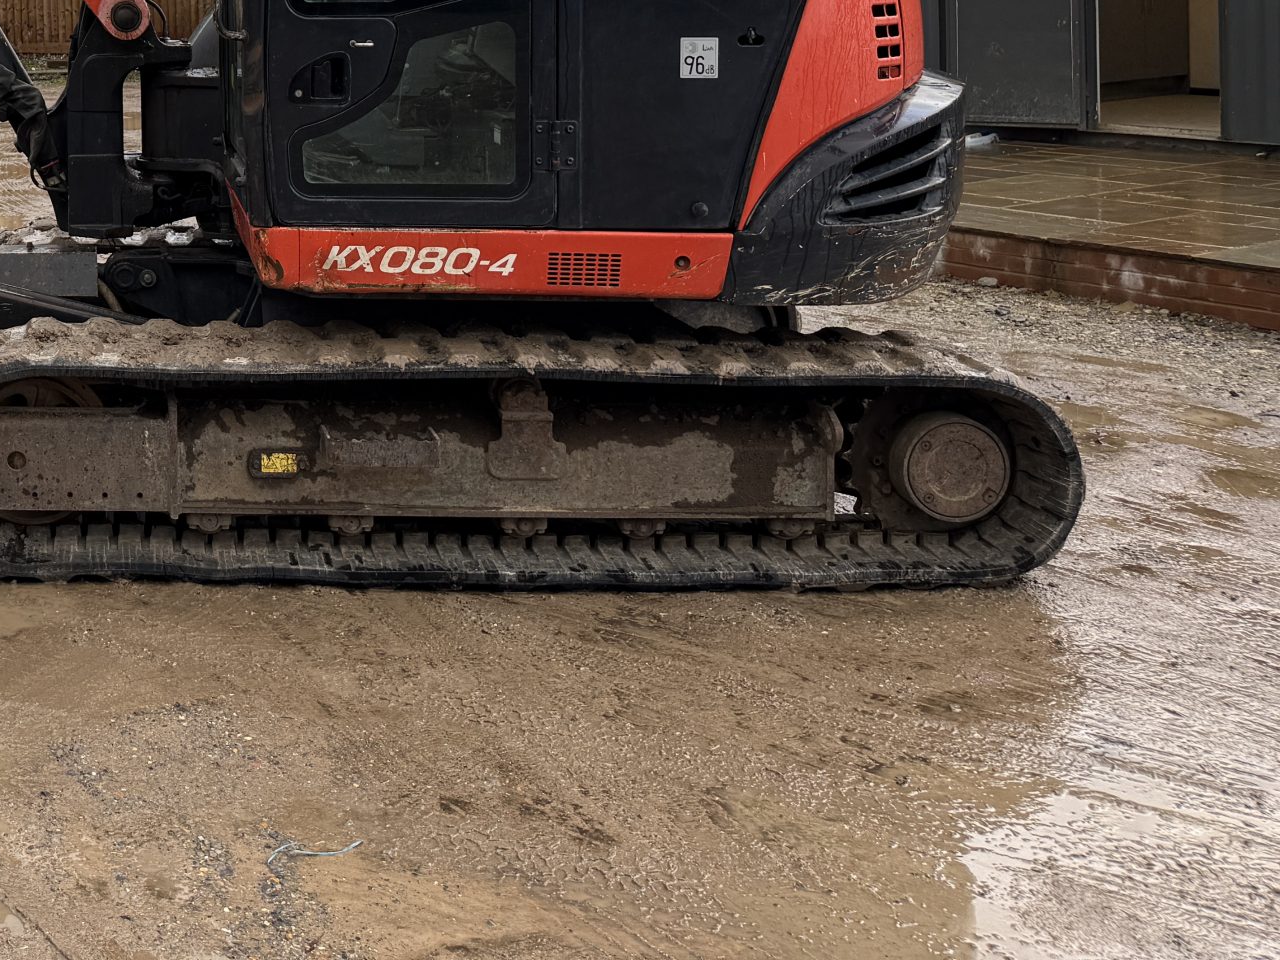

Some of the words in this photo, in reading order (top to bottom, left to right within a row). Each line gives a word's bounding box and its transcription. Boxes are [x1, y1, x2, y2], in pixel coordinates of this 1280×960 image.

[684, 55, 705, 75] 96
[705, 64, 715, 75] dB
[322, 245, 518, 276] KX080-4
